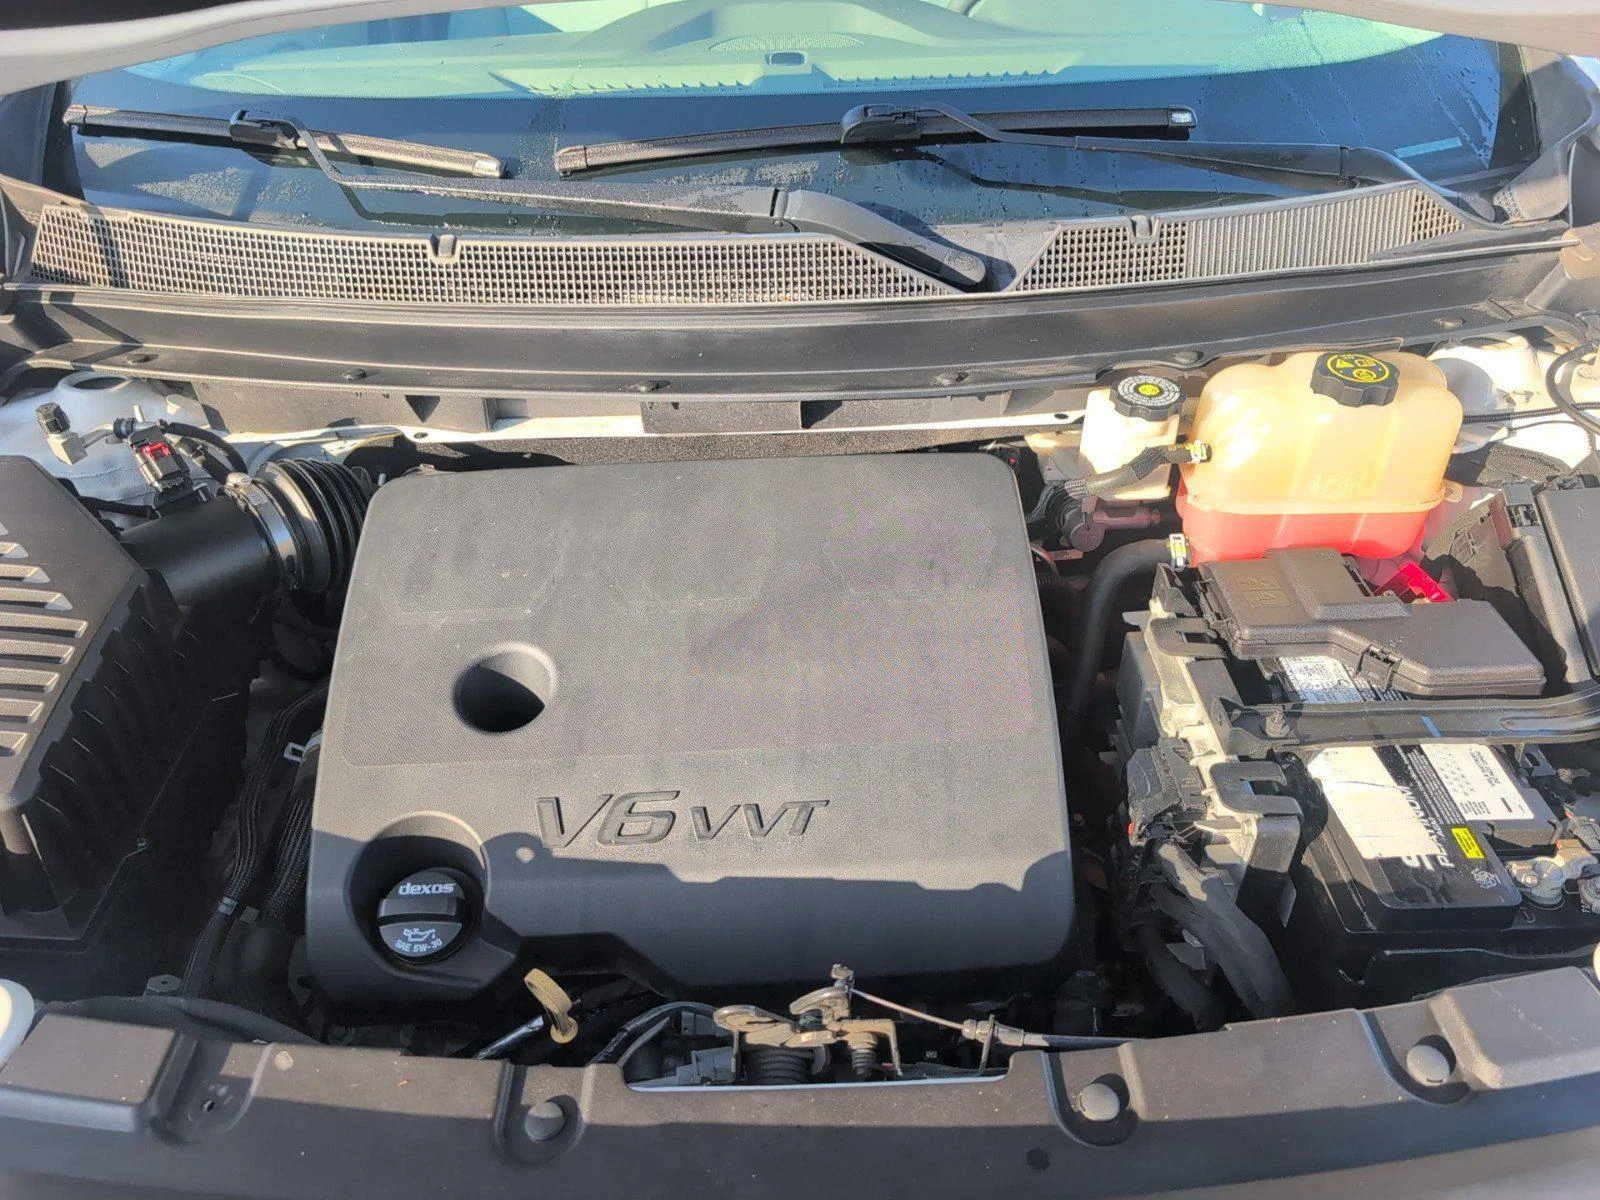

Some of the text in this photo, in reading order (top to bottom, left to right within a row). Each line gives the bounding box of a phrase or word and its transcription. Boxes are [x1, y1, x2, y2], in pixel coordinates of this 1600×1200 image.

[535, 790, 830, 848] V6 VVT
[398, 882, 456, 895] dexos
[395, 938, 442, 953] SAE 5W-30
